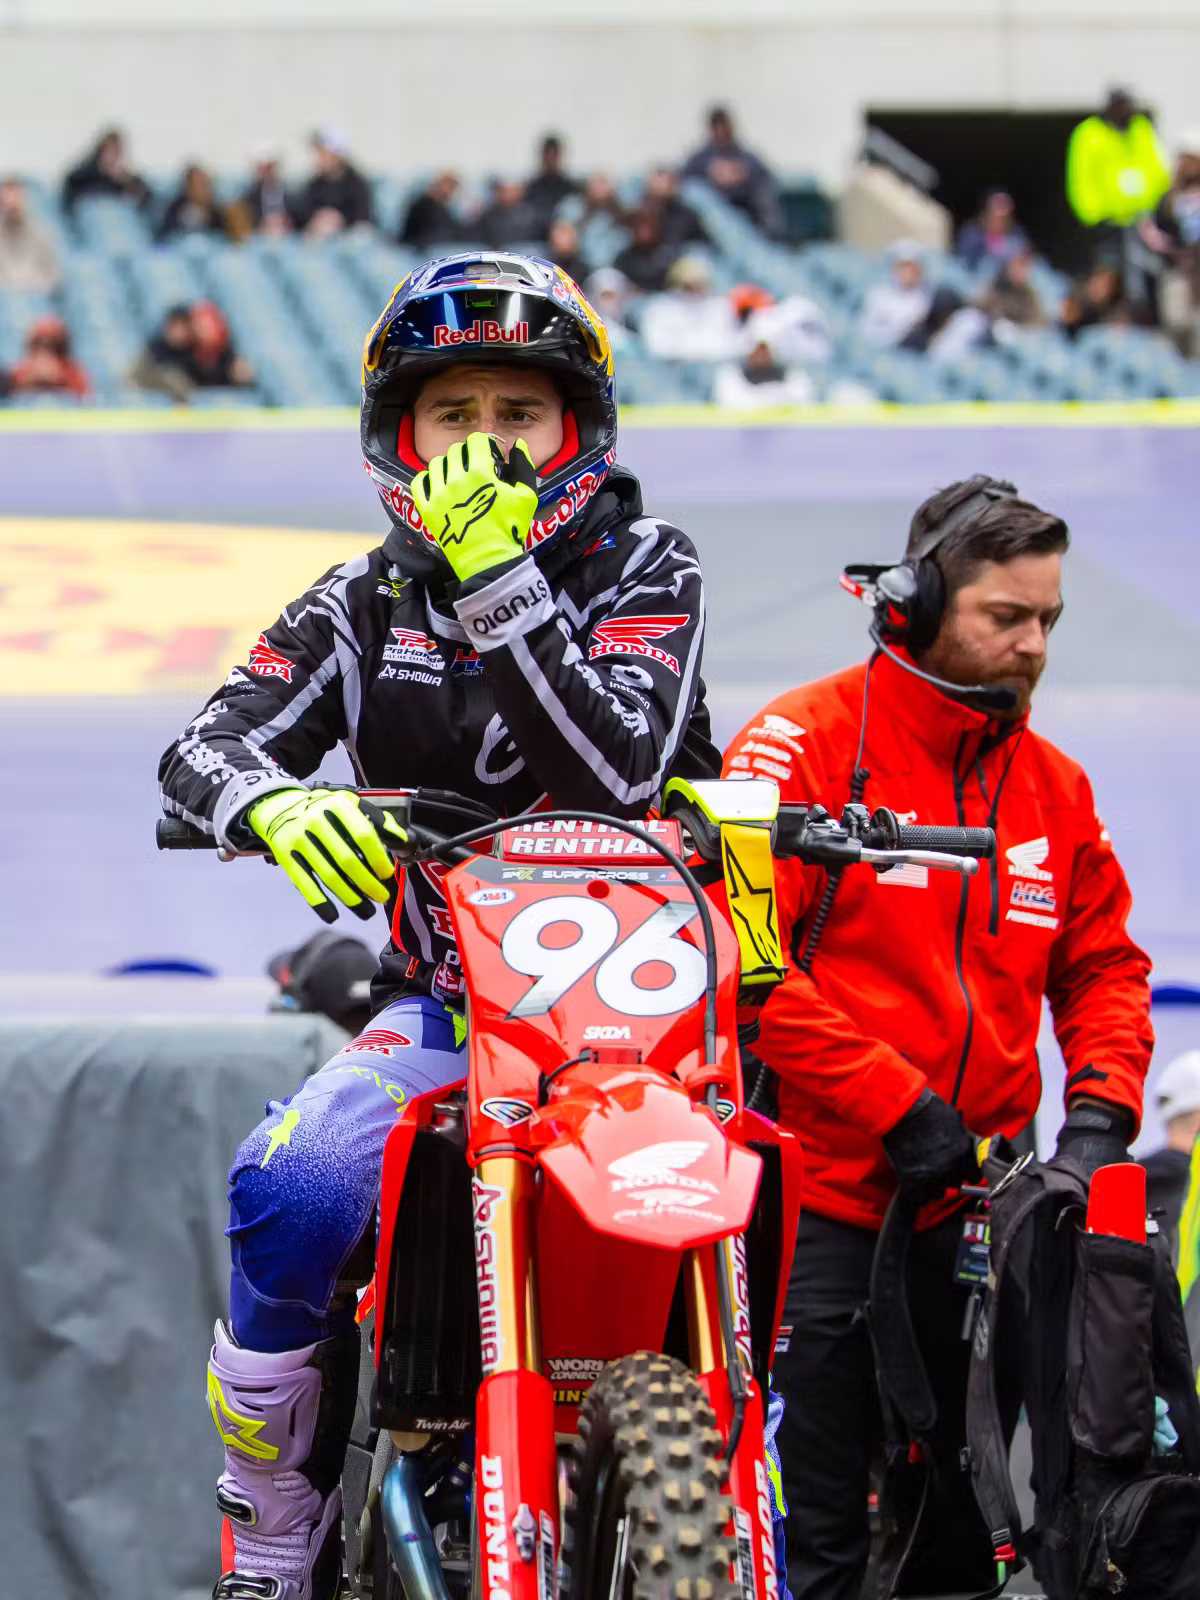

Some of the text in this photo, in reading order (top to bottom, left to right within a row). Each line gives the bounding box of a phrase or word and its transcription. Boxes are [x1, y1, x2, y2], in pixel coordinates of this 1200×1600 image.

[433, 319, 529, 347] Red Bull
[473, 579, 547, 634] STUDIO
[249, 664, 292, 684] NDA
[589, 642, 681, 678] HONDA
[397, 669, 443, 687] SHOWA
[511, 837, 665, 855] RENTHA
[501, 895, 709, 1021] 96
[550, 1371, 601, 1380] CONNECT
[416, 1419, 470, 1431] Twin Air
[481, 1454, 511, 1600] DUNL
[754, 1459, 780, 1600] NLOP
